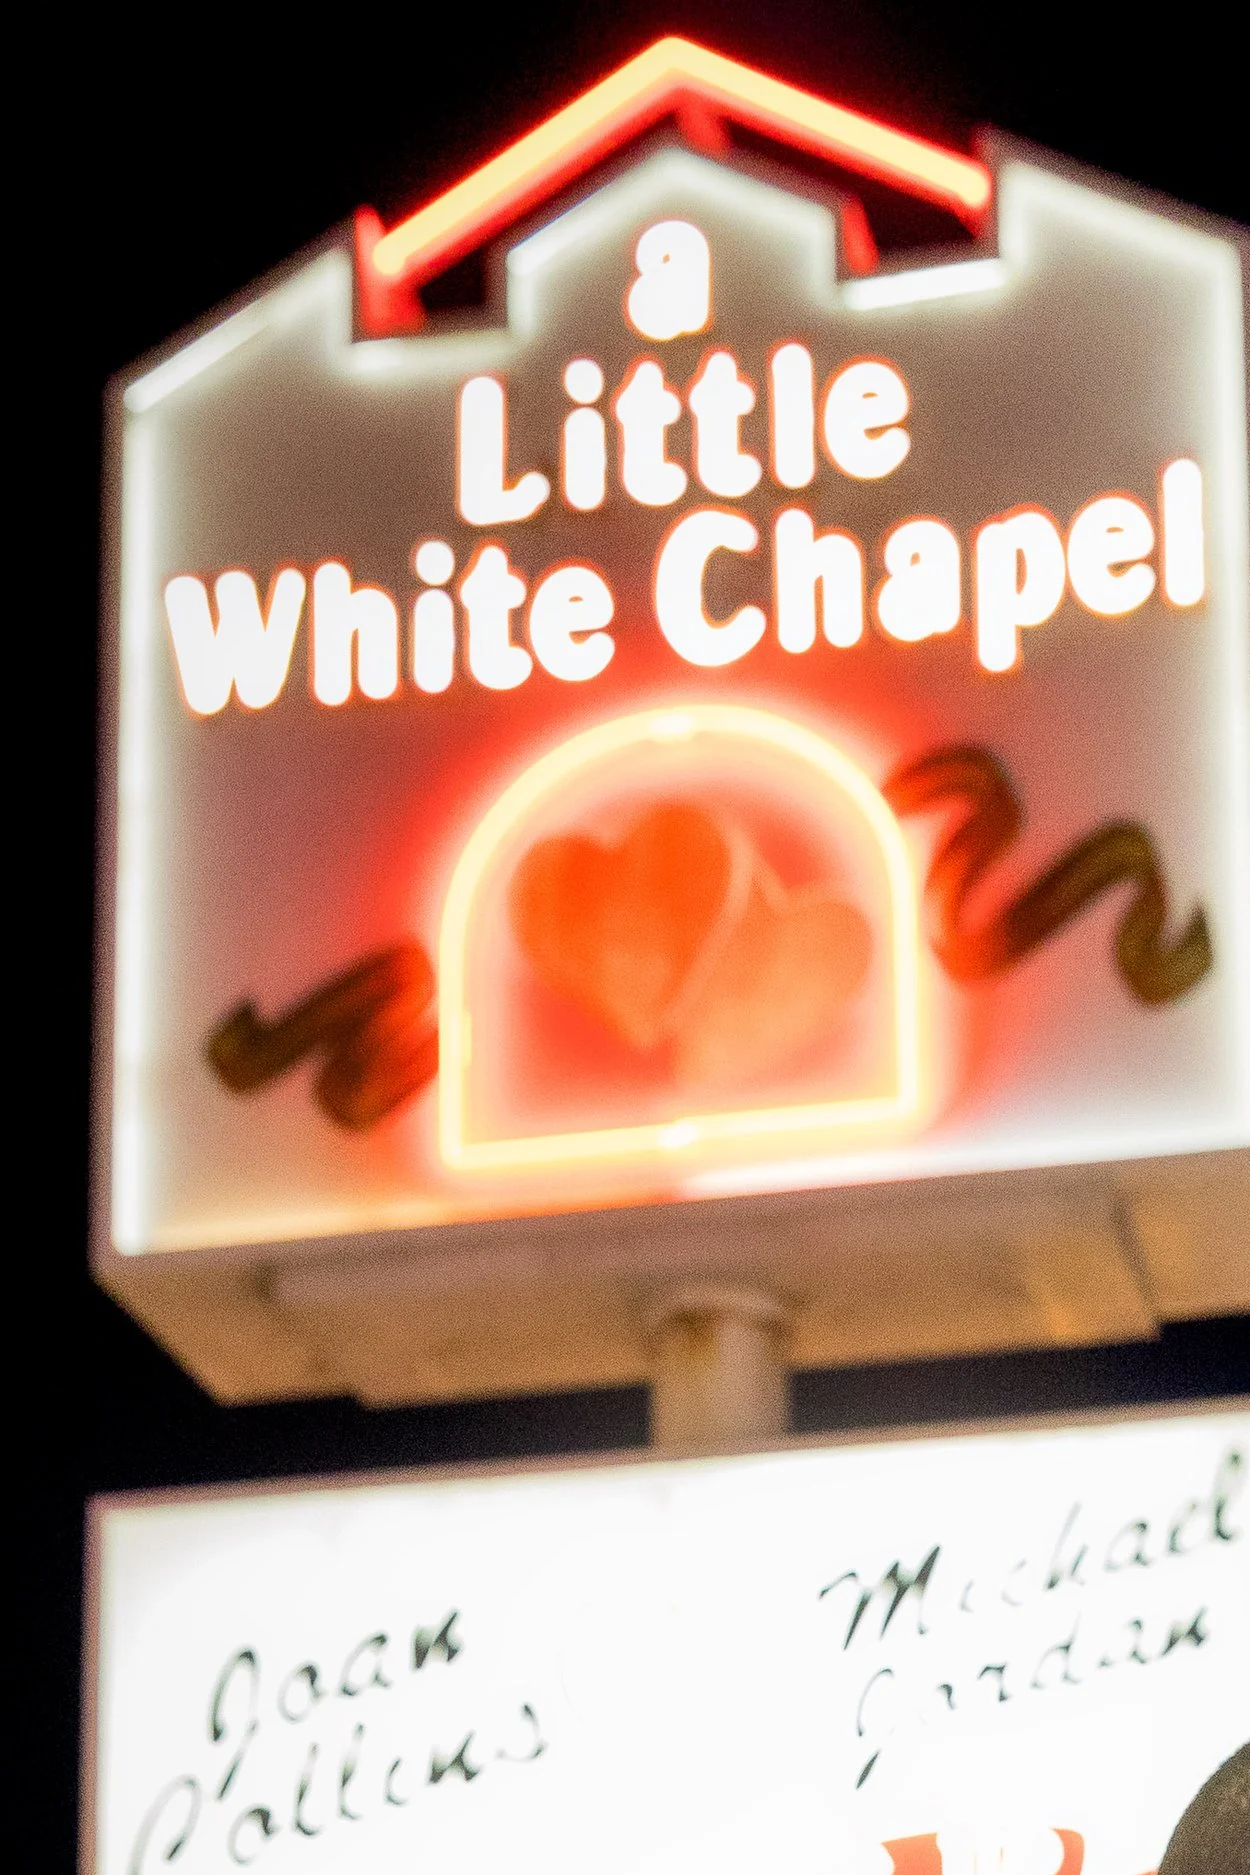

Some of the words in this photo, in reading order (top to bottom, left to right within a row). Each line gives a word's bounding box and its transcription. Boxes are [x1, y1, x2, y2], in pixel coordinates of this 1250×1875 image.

[627, 219, 711, 341] a
[458, 343, 911, 526] Little
[163, 541, 617, 716] White
[654, 457, 1206, 674] Chapel
[208, 1608, 466, 1803] Joan
